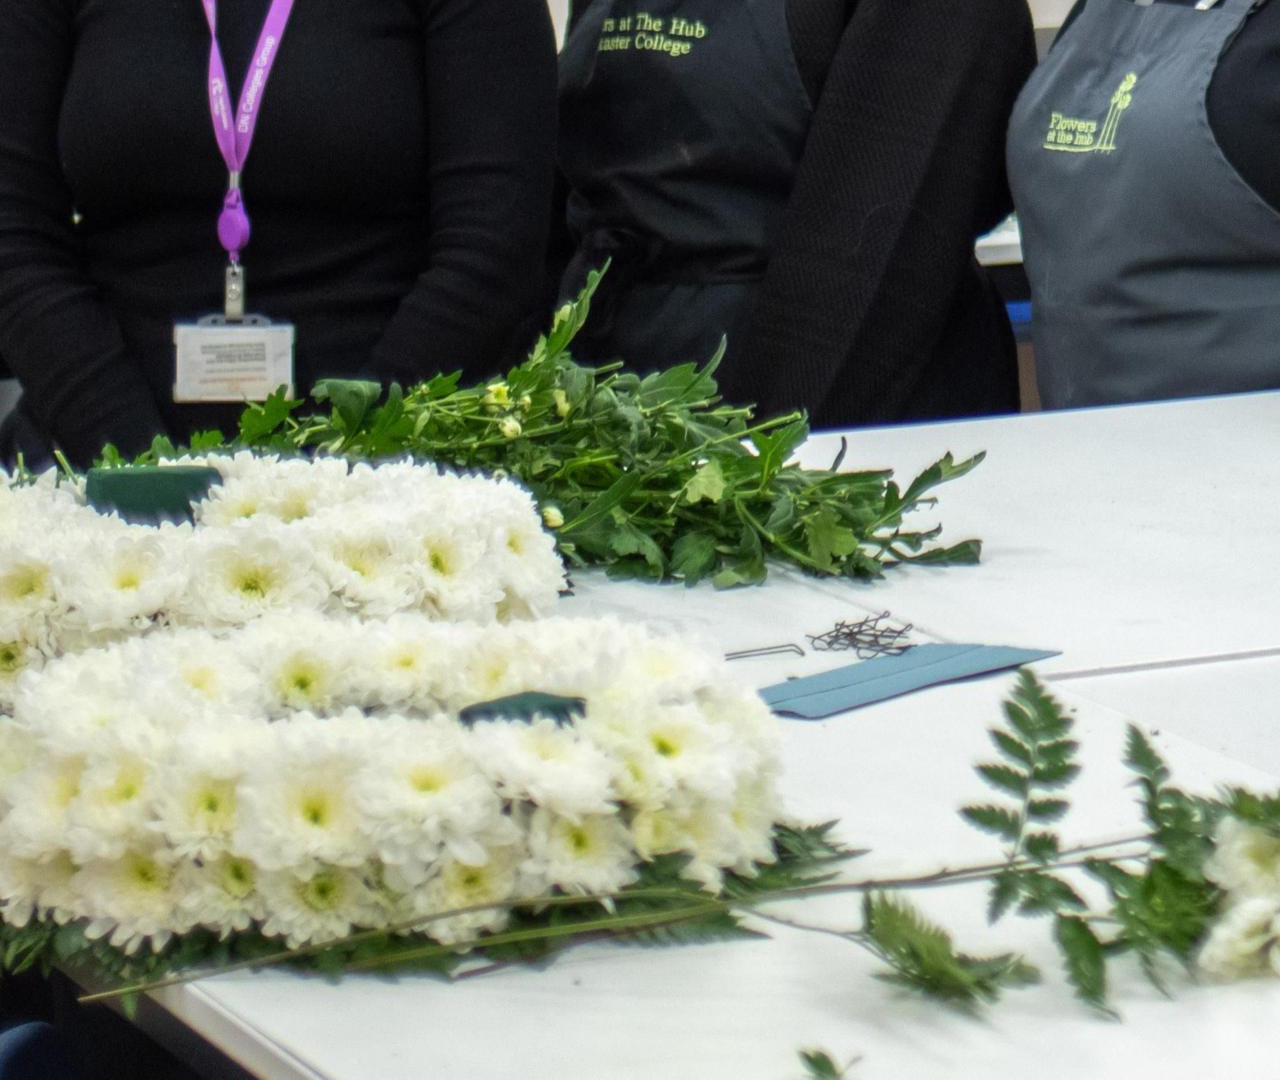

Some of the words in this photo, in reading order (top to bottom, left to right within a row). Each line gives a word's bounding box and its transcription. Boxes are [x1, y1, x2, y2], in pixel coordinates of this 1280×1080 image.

[619, 16, 631, 32] at
[635, 12, 663, 32] The
[669, 17, 707, 39] Hub
[635, 32, 692, 57] College
[1049, 111, 1097, 133] Flowers
[1057, 130, 1074, 145] the
[1073, 133, 1094, 146] hub
